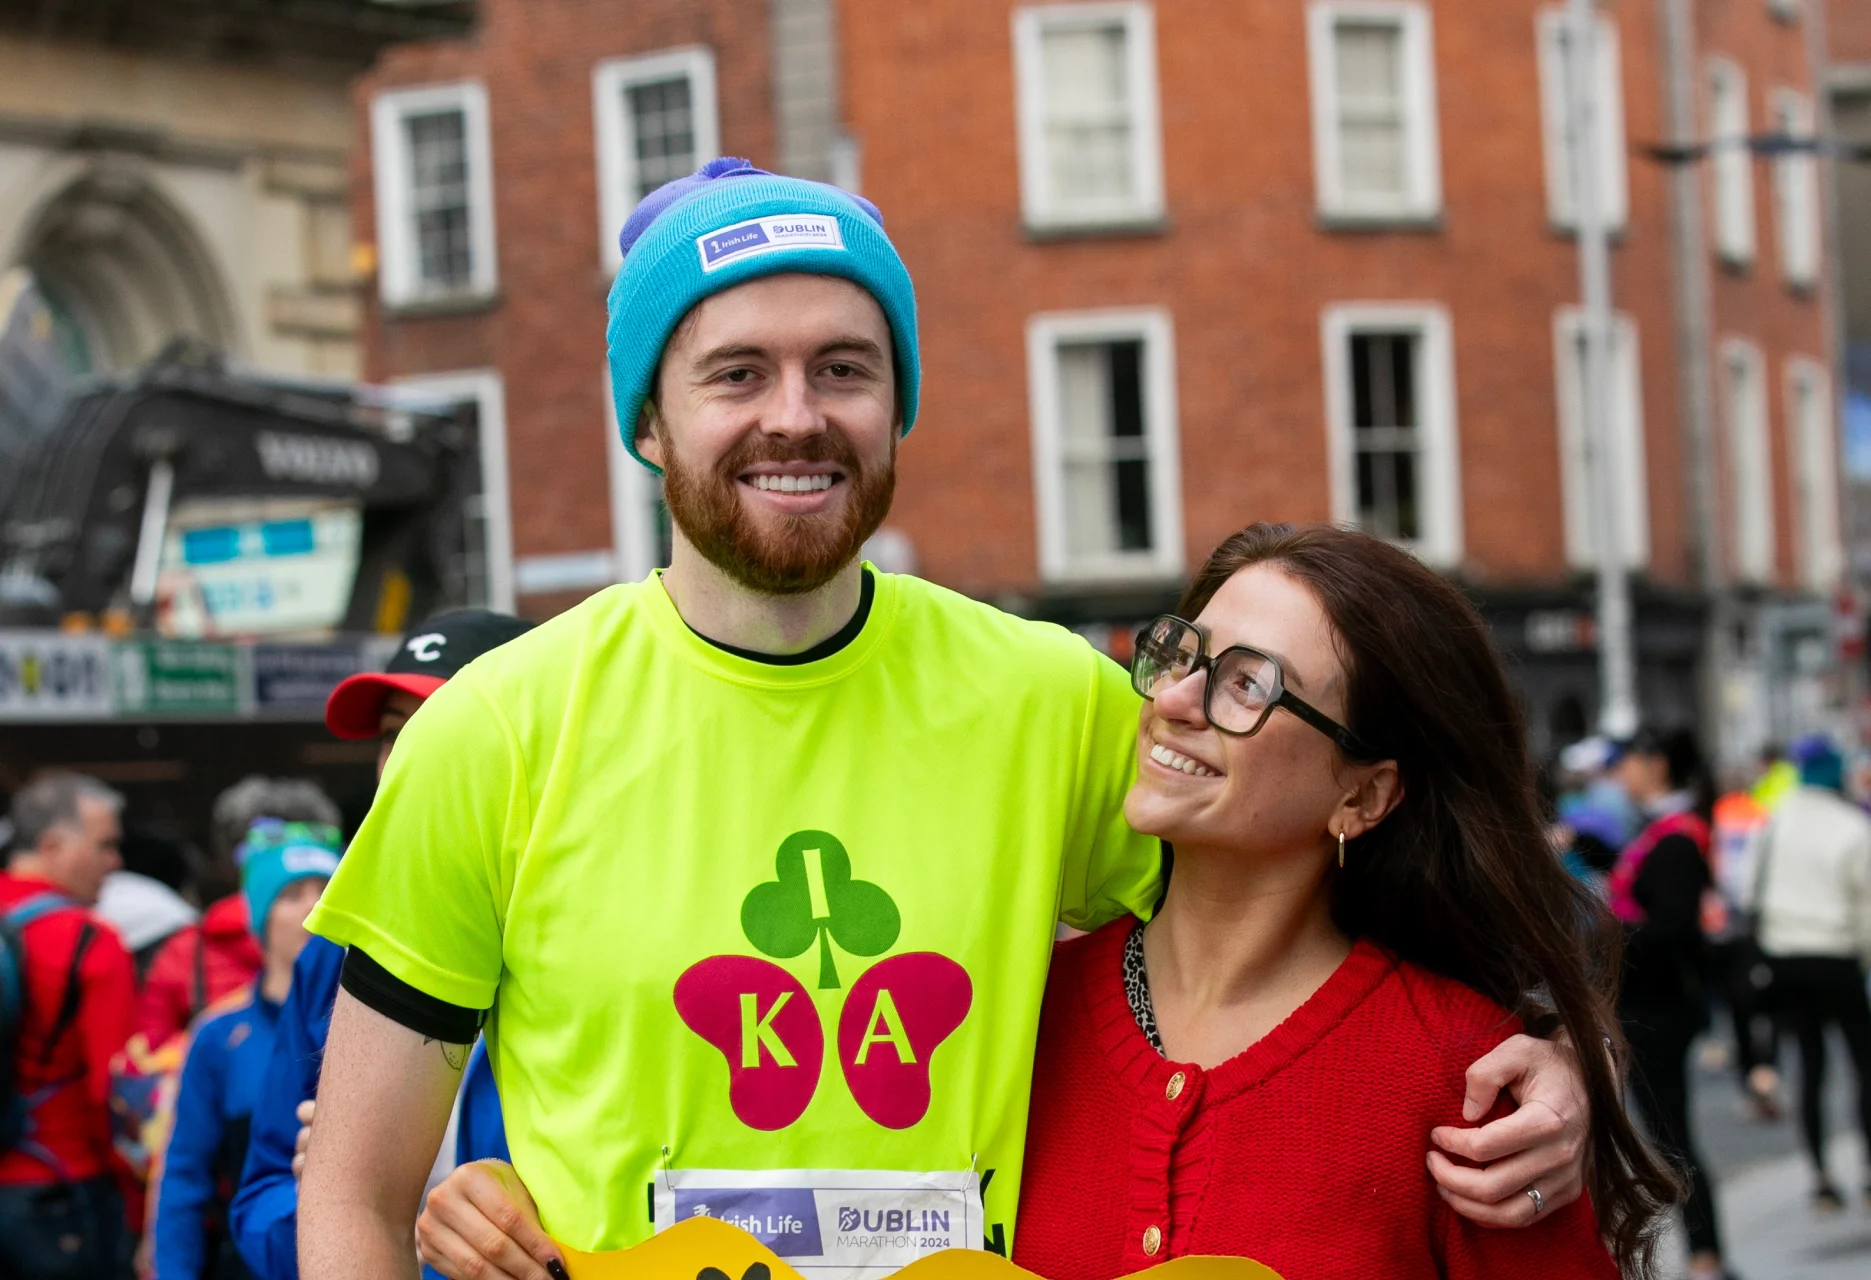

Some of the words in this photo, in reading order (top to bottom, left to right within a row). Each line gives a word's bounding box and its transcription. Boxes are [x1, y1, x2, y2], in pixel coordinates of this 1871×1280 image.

[773, 224, 826, 234] DUBLIN
[721, 236, 741, 248] Irish
[742, 232, 759, 243] Life
[767, 1215, 803, 1234] Life
[838, 1206, 950, 1232] DUBLIN
[836, 1235, 917, 1248] MARATHON
[920, 1237, 951, 1248] 2024
